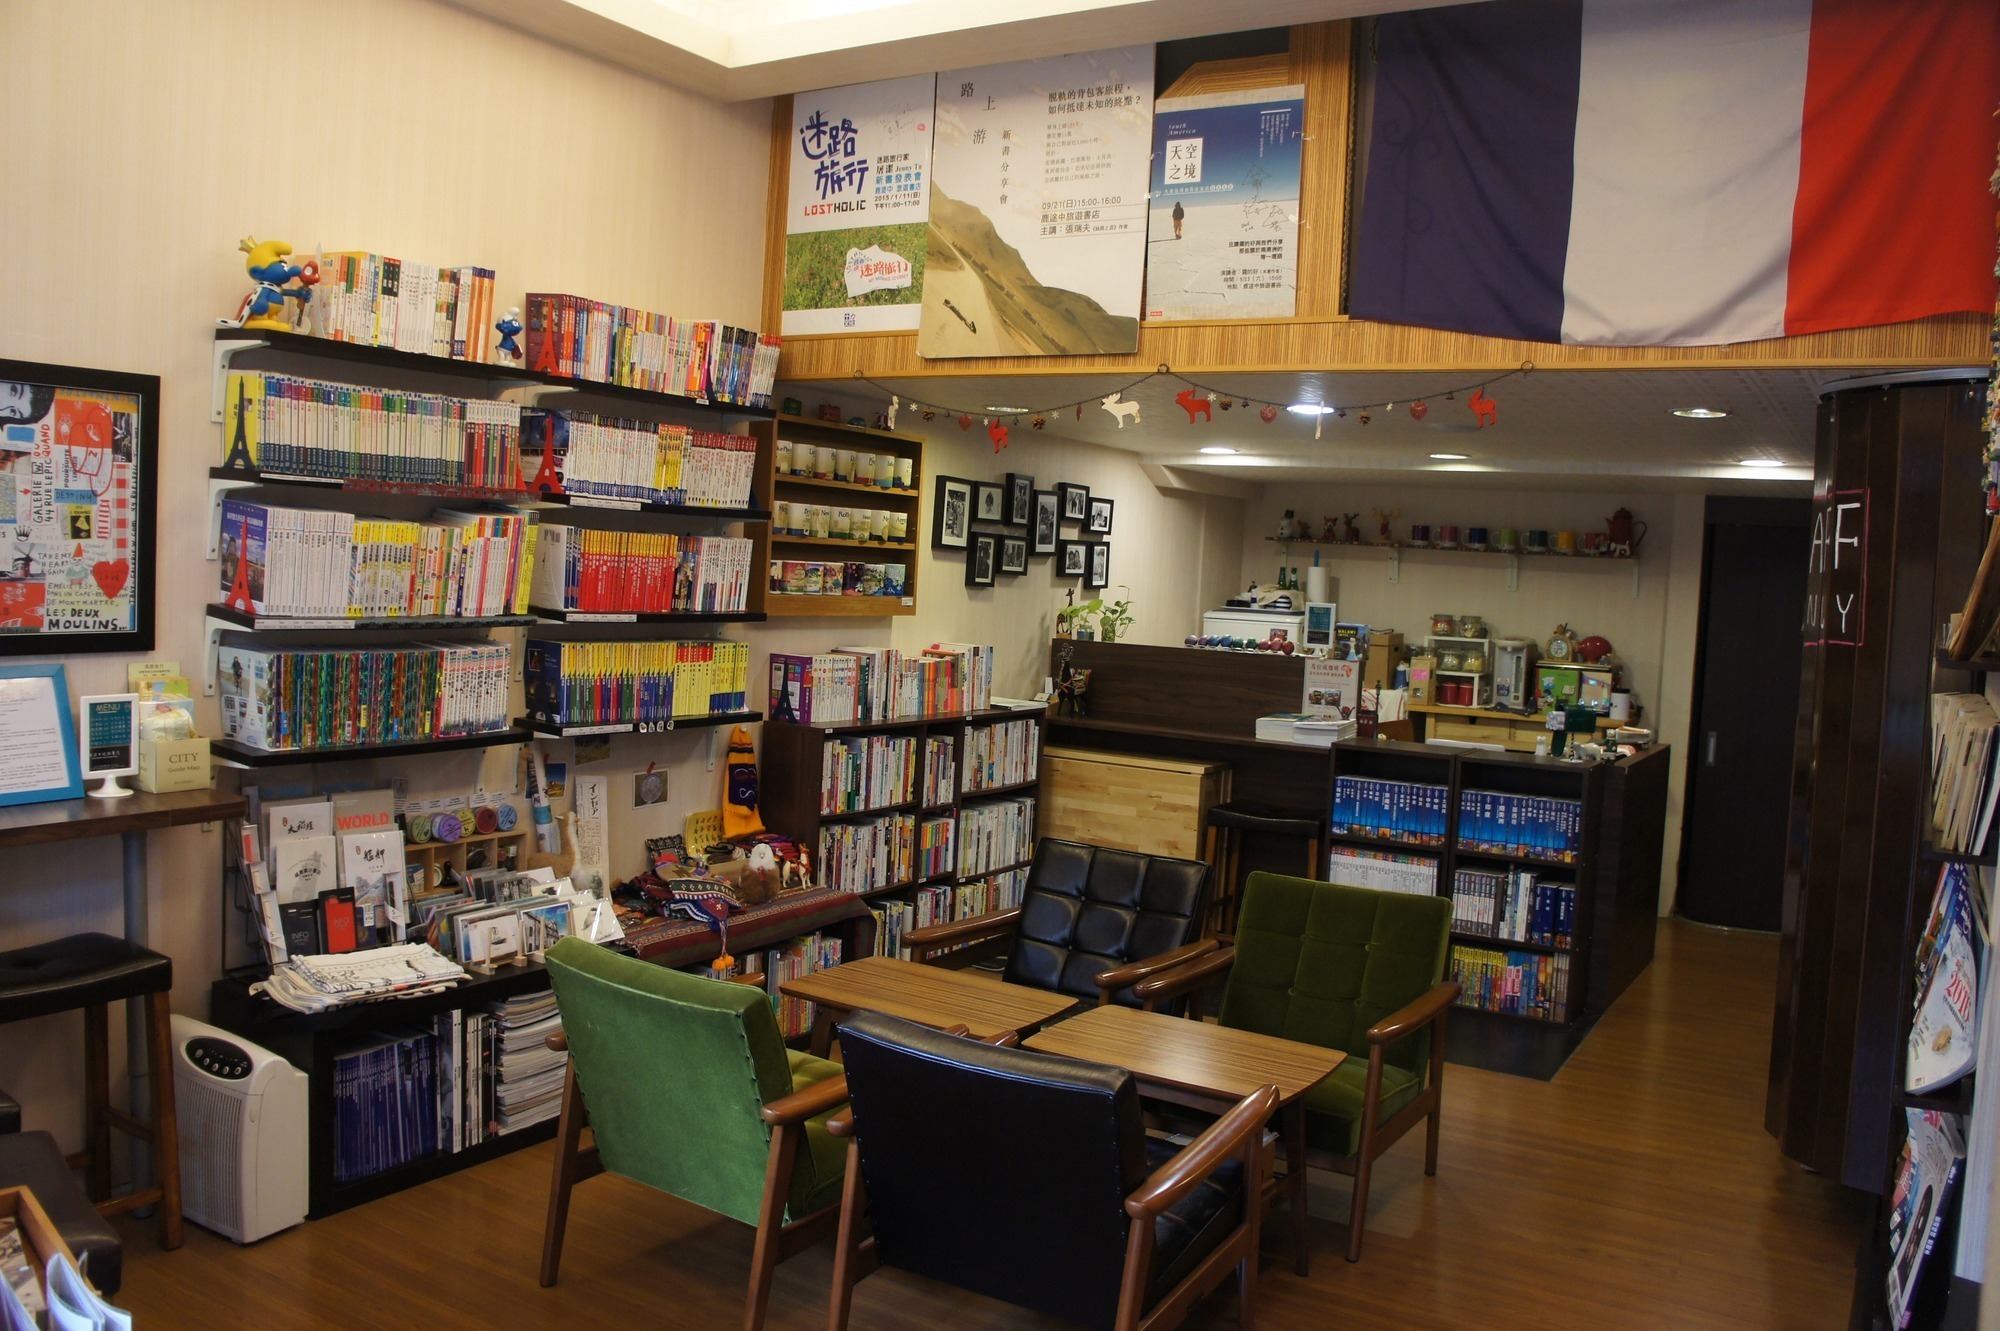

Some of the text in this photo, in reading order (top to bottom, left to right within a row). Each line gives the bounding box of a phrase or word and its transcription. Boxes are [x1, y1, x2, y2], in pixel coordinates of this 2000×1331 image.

[960, 82, 974, 98] 路
[983, 96, 997, 111] 上
[799, 108, 859, 161] 迷路
[972, 128, 987, 145] 游
[876, 153, 911, 164] 迷路旅行家
[1170, 143, 1198, 161] 天空
[999, 129, 1012, 205] 新書分享會
[1168, 162, 1197, 180] 之境
[814, 159, 870, 201] 旅行
[875, 171, 922, 184] 新書發表會
[804, 199, 867, 217] LOSTHOLIC
[1040, 210, 1100, 223] 鹿途中旅遊書店
[1040, 223, 1091, 236] 主講：張瑞夫
[40, 424, 51, 457] QUAND
[44, 458, 55, 523] 44 RUE LEPIC
[55, 491, 93, 500] DESTINY
[33, 479, 43, 523] GALERIE
[41, 560, 69, 568] HEART
[46, 599, 60, 607] DE
[46, 608, 100, 618] LES DEUX
[96, 703, 121, 711] MENU
[169, 752, 200, 764] CITY
[337, 812, 390, 831] WORLD
[332, 916, 349, 926] INFO
[291, 931, 310, 940] INFO
